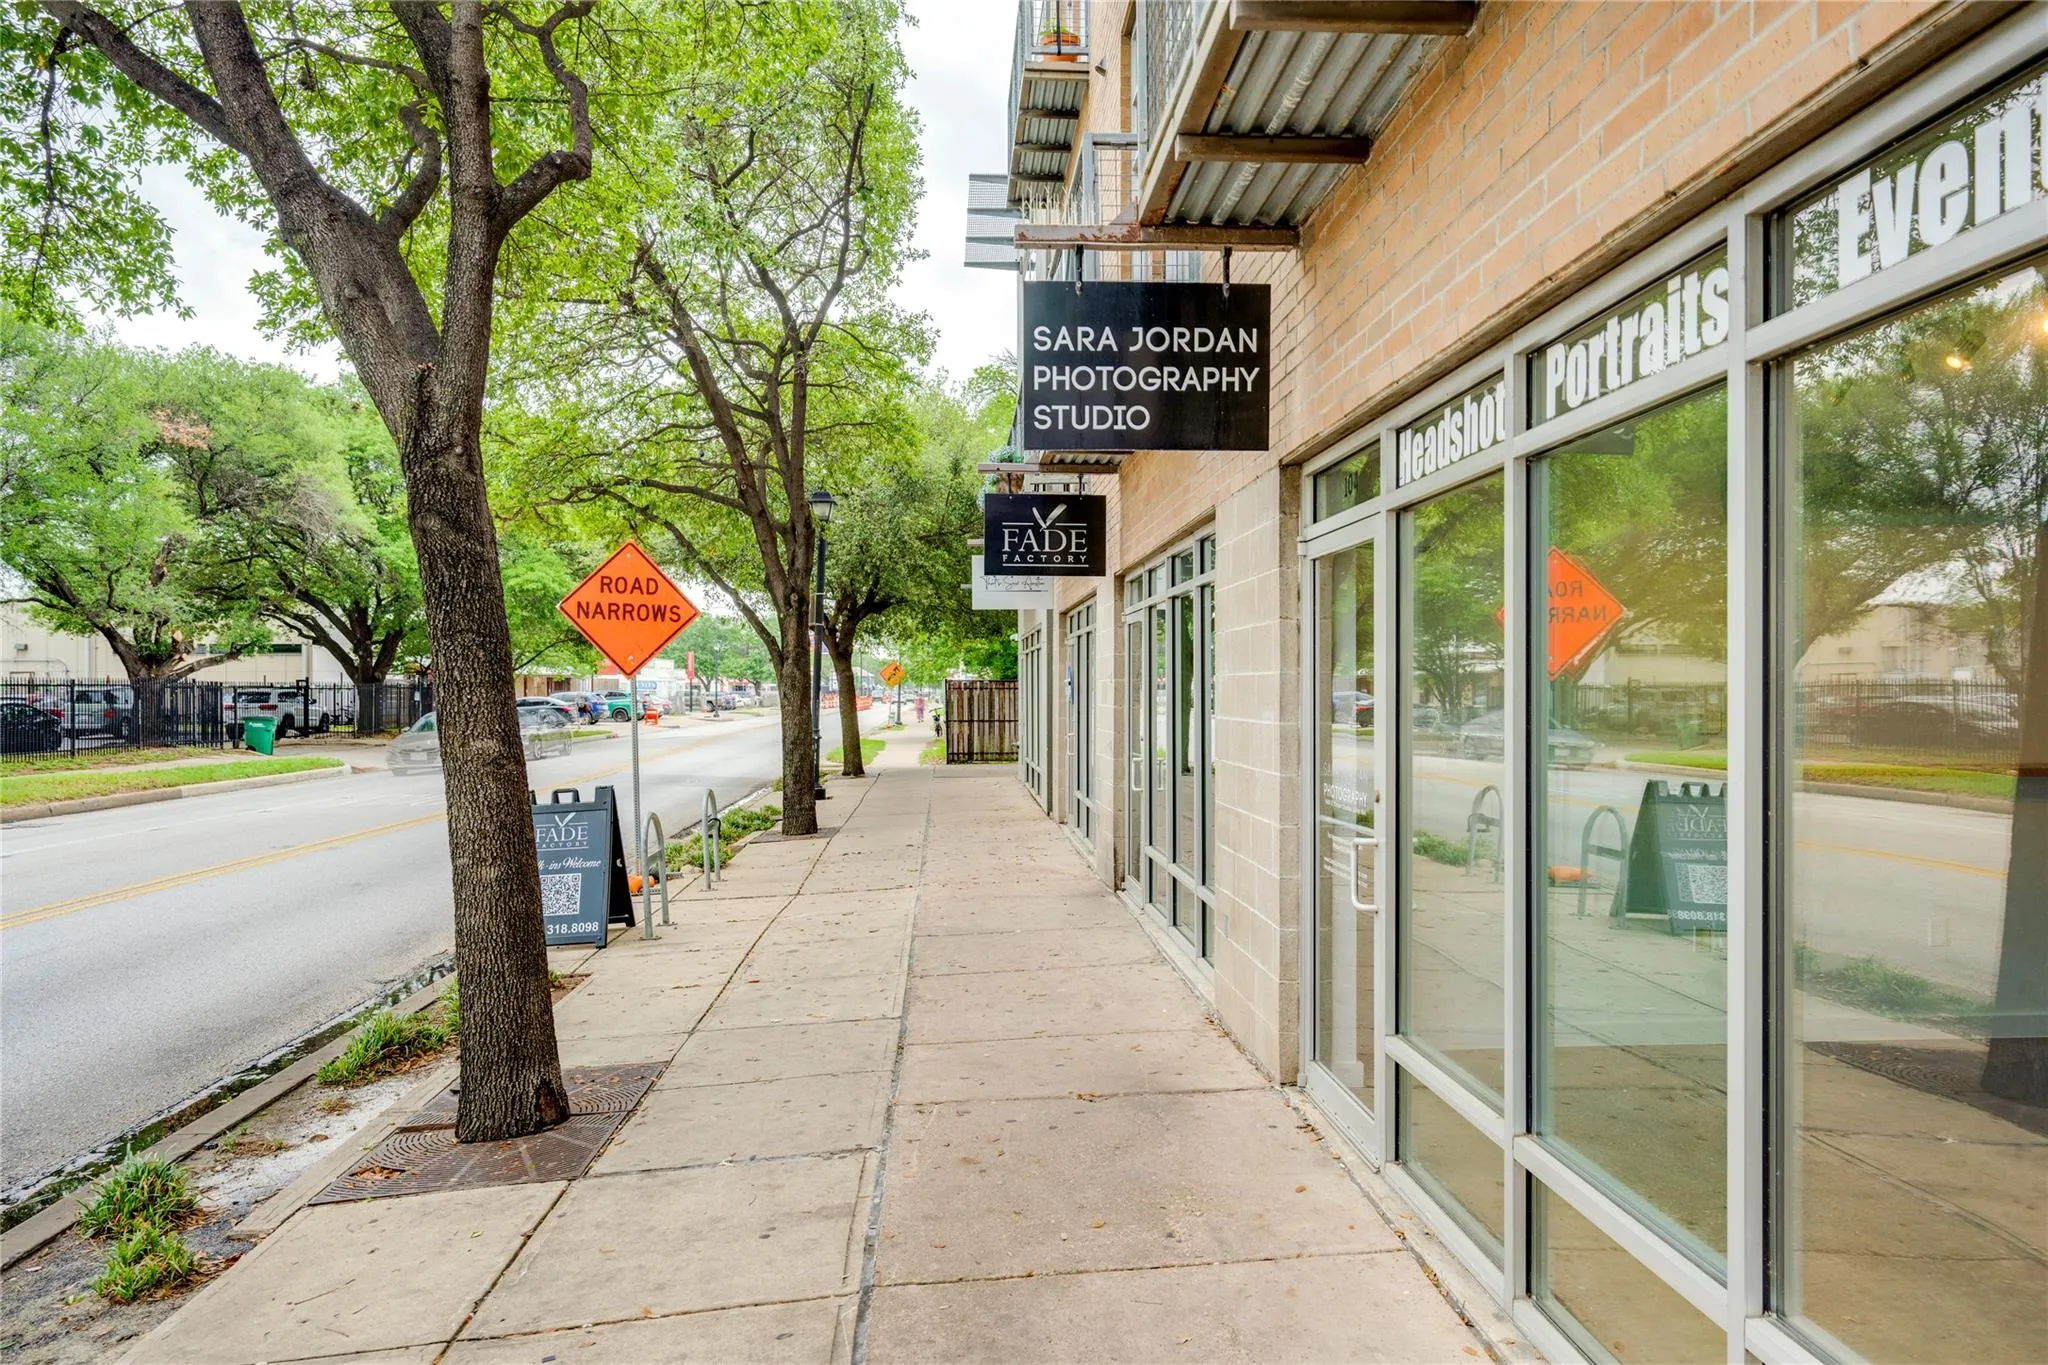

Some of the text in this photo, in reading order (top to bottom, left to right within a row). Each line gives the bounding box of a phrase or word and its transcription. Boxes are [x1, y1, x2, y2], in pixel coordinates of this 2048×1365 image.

[1838, 74, 2048, 290] Even
[1033, 326, 1258, 353] SARA JORDAN
[1546, 267, 1729, 420] Portraits
[1033, 366, 1260, 392] PHOTOGRAPHY
[1033, 405, 1150, 431] STUDIO
[1398, 380, 1505, 487] Headshot
[1002, 528, 1088, 553] FADE
[1002, 554, 1087, 563] FACTORY
[600, 575, 659, 596] ROAD
[576, 600, 682, 623] NARROWS
[535, 825, 589, 843] FADE
[562, 856, 602, 869] Welcome
